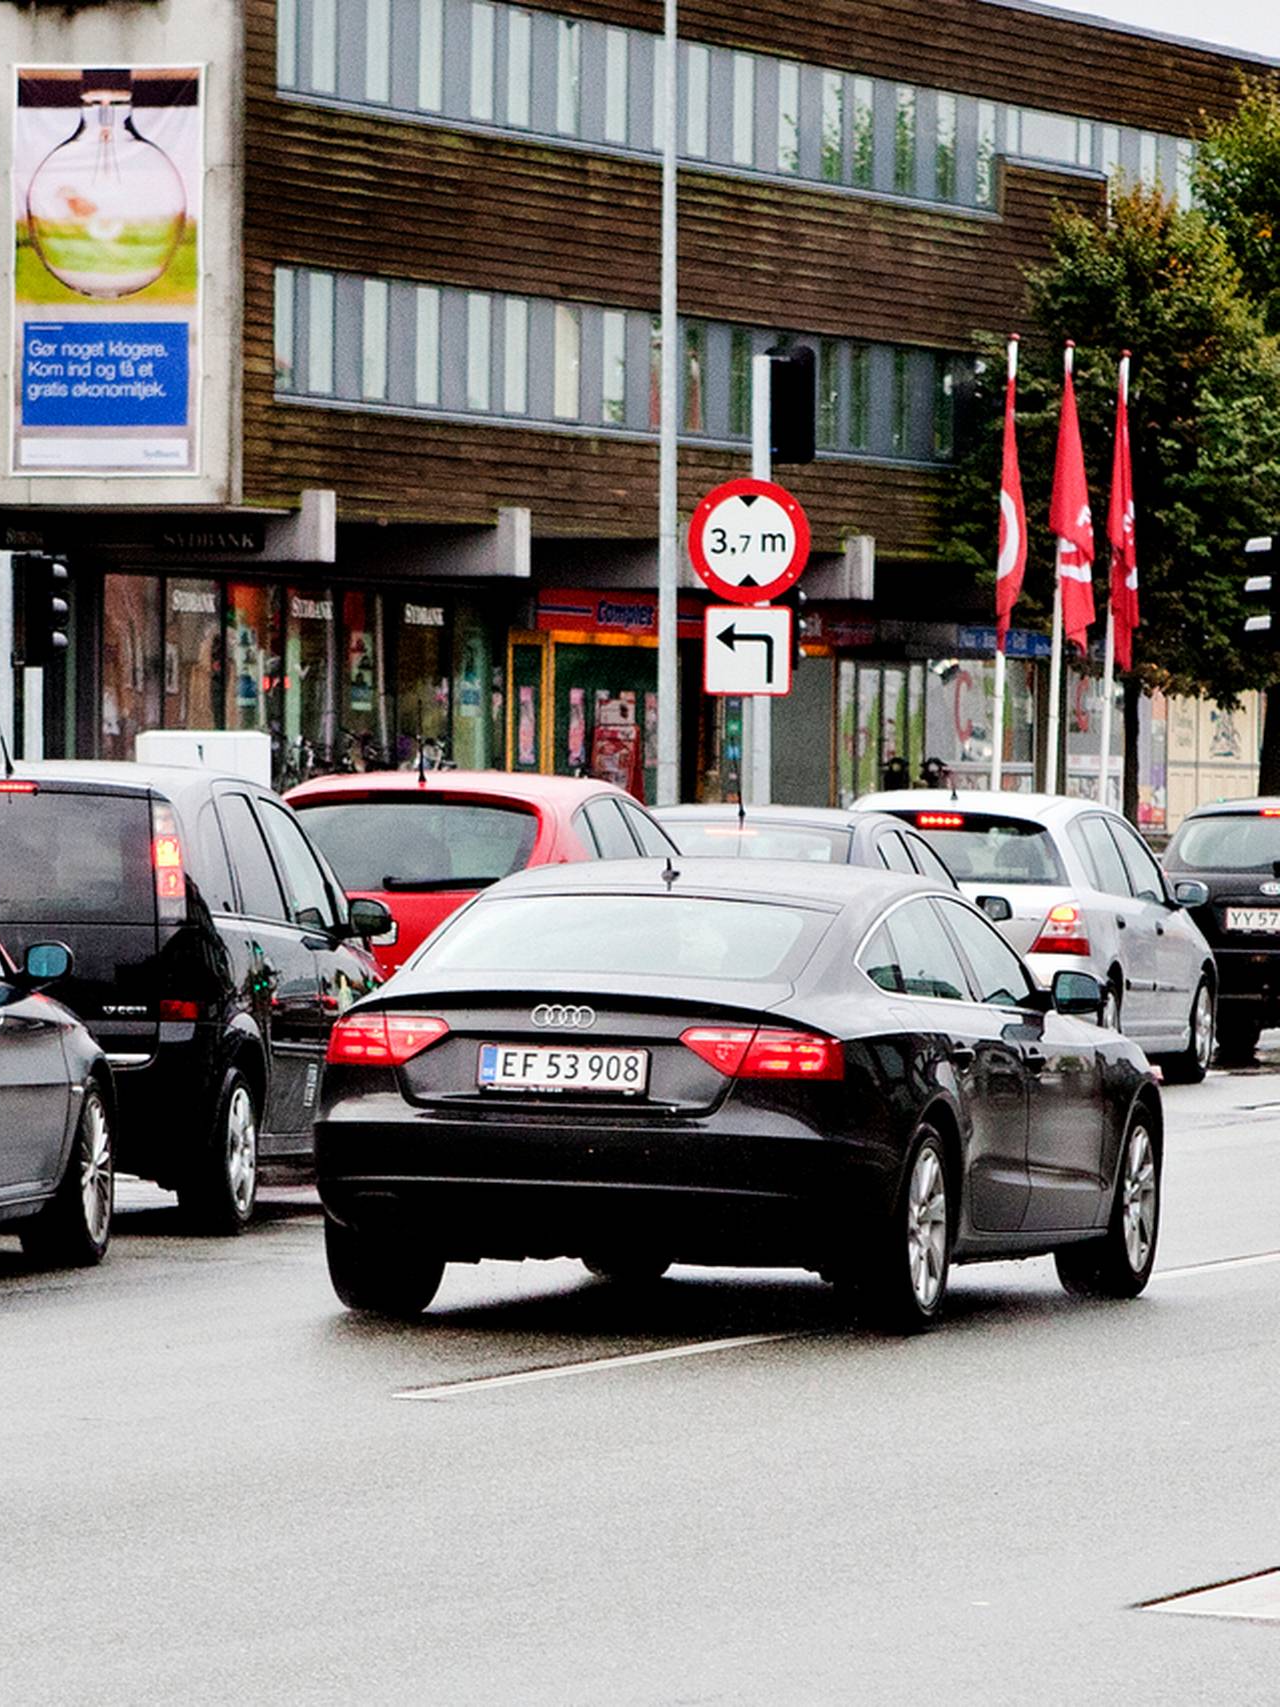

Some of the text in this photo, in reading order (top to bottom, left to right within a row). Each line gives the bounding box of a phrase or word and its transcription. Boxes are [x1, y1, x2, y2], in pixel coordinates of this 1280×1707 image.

[29, 339, 169, 361] Gør noget klogere.
[27, 361, 64, 377] Kom
[67, 361, 92, 377] ind
[95, 365, 116, 381] og
[138, 362, 154, 377] et
[27, 381, 69, 401] gratis
[1231, 911, 1279, 927] YY 57
[501, 1051, 639, 1082] EF 53 908
